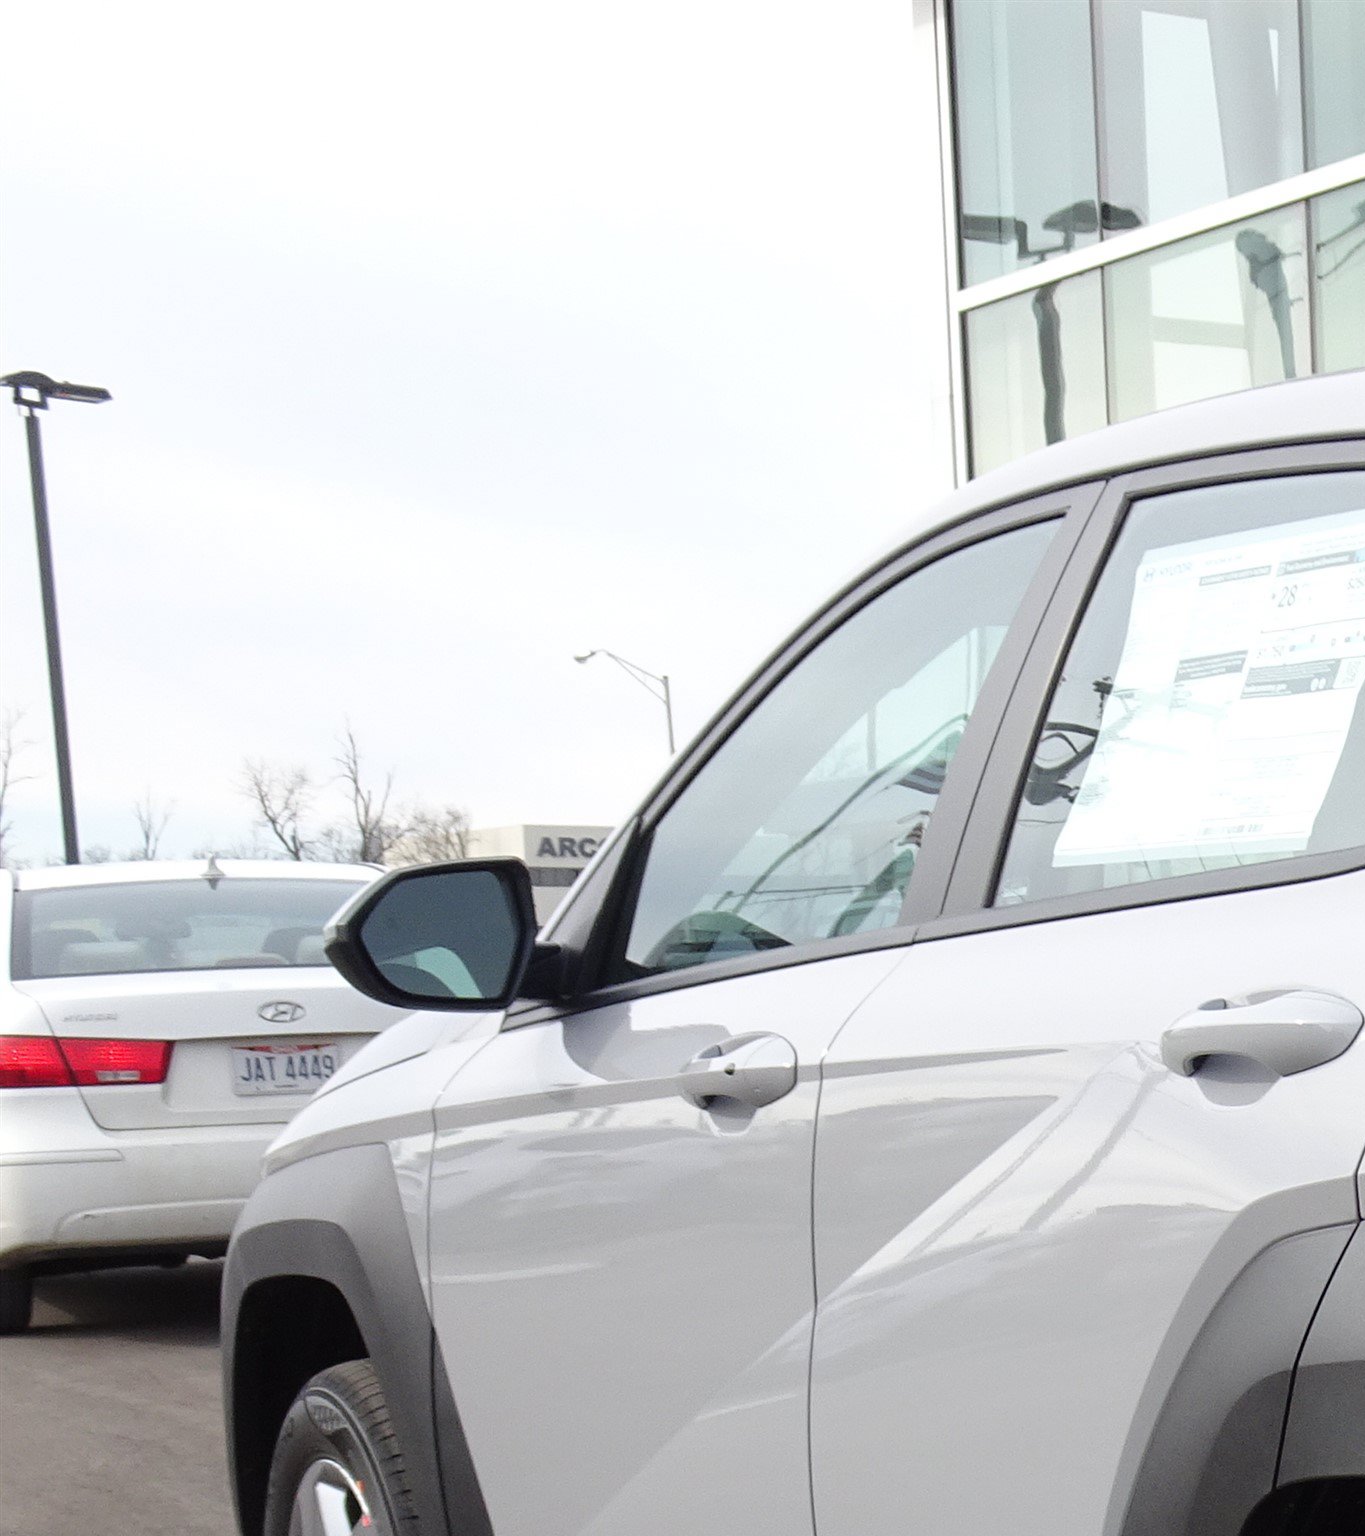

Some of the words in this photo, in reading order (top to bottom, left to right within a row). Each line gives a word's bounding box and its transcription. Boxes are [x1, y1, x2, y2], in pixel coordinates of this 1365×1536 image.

[537, 836, 606, 858] ARC
[240, 1057, 276, 1081] JAT
[286, 1054, 335, 1080] 4449
